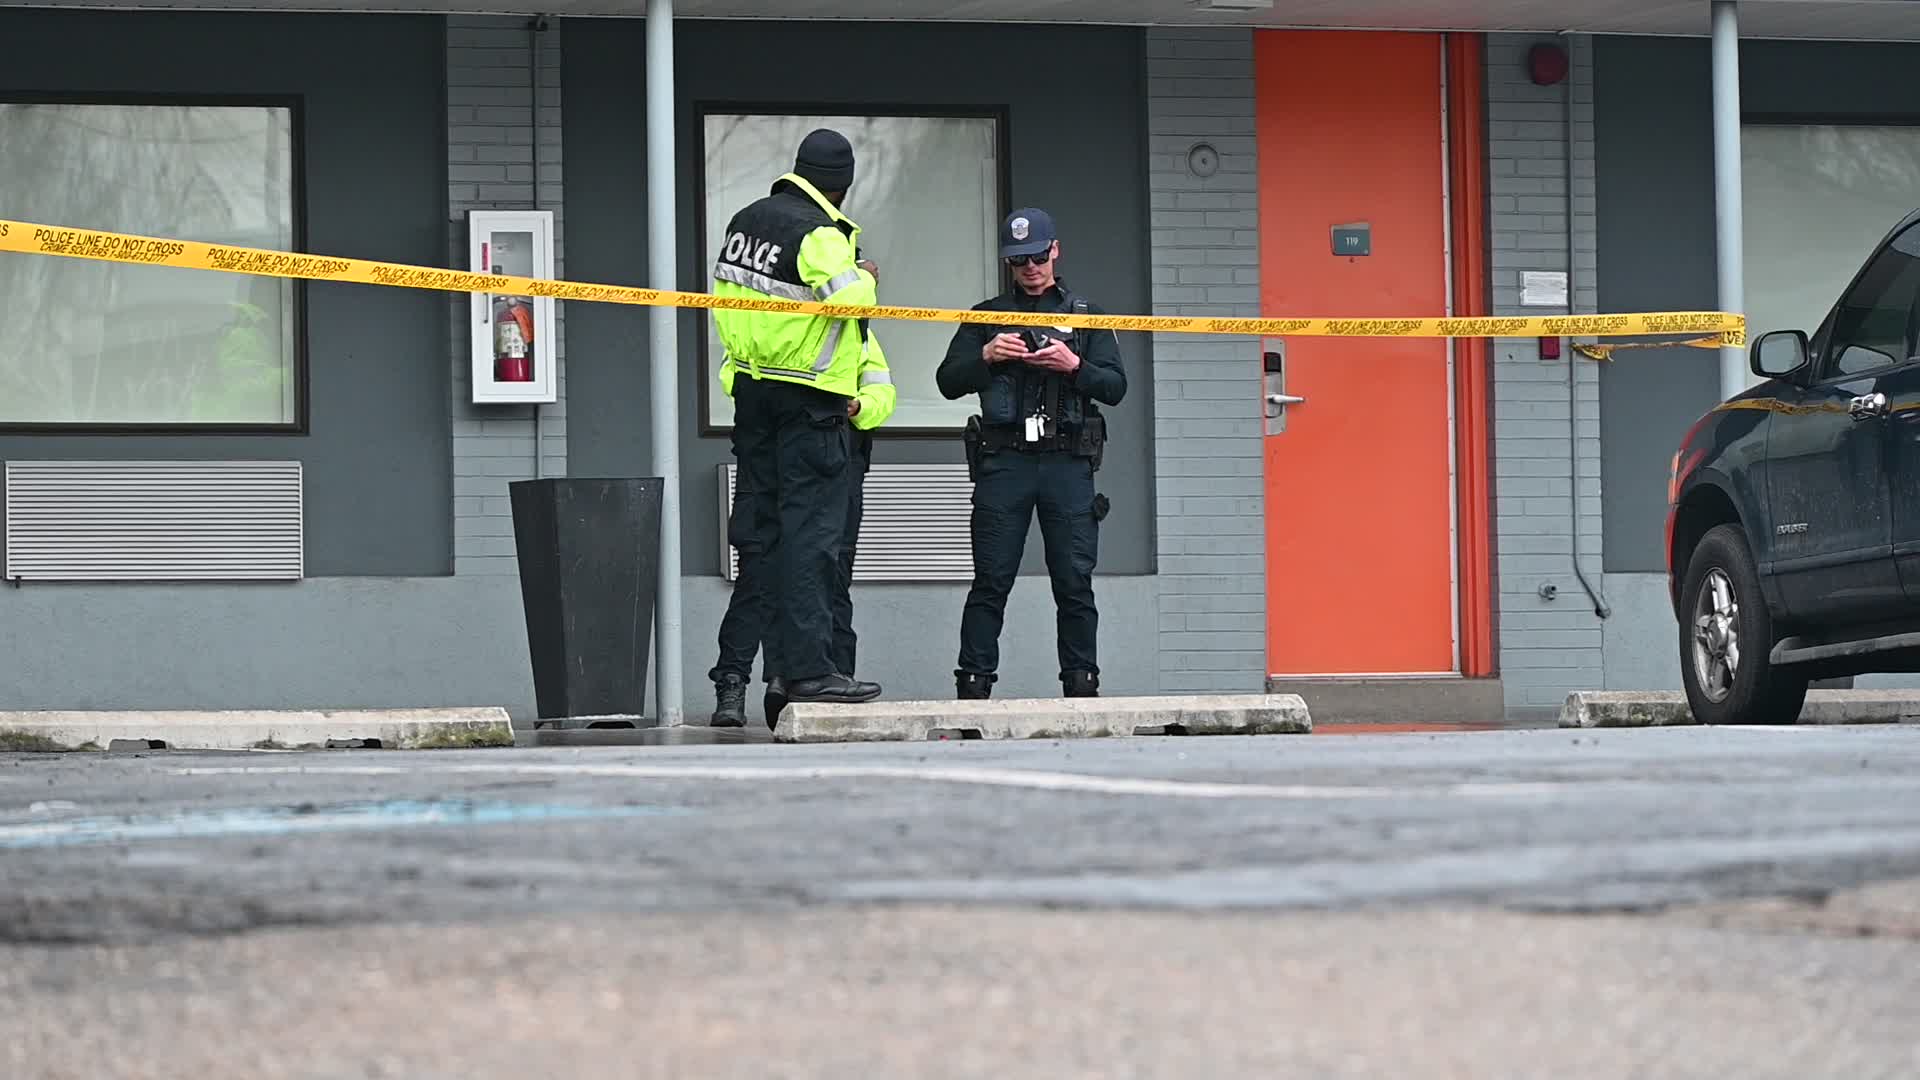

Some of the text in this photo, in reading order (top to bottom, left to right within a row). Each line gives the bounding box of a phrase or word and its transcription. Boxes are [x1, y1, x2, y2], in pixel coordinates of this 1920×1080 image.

[34, 229, 184, 255] POLICE LINE DO NOT CROSS
[1345, 236, 1359, 247] 119
[206, 248, 247, 262] POLICE
[247, 253, 272, 264] LINE
[272, 255, 289, 266] DO
[290, 257, 313, 270] NOT
[314, 260, 351, 272] CROSS
[724, 231, 782, 275] OLICE
[370, 266, 410, 279] POLICE
[409, 270, 434, 281] LINE
[433, 273, 450, 282] DO
[452, 273, 473, 285] NOT
[472, 276, 509, 288] CROSS
[1541, 316, 1628, 328] POLICE LINE DO NOT CROSS
[1642, 314, 1724, 325] POLICE LINE DO NOT CROSS
